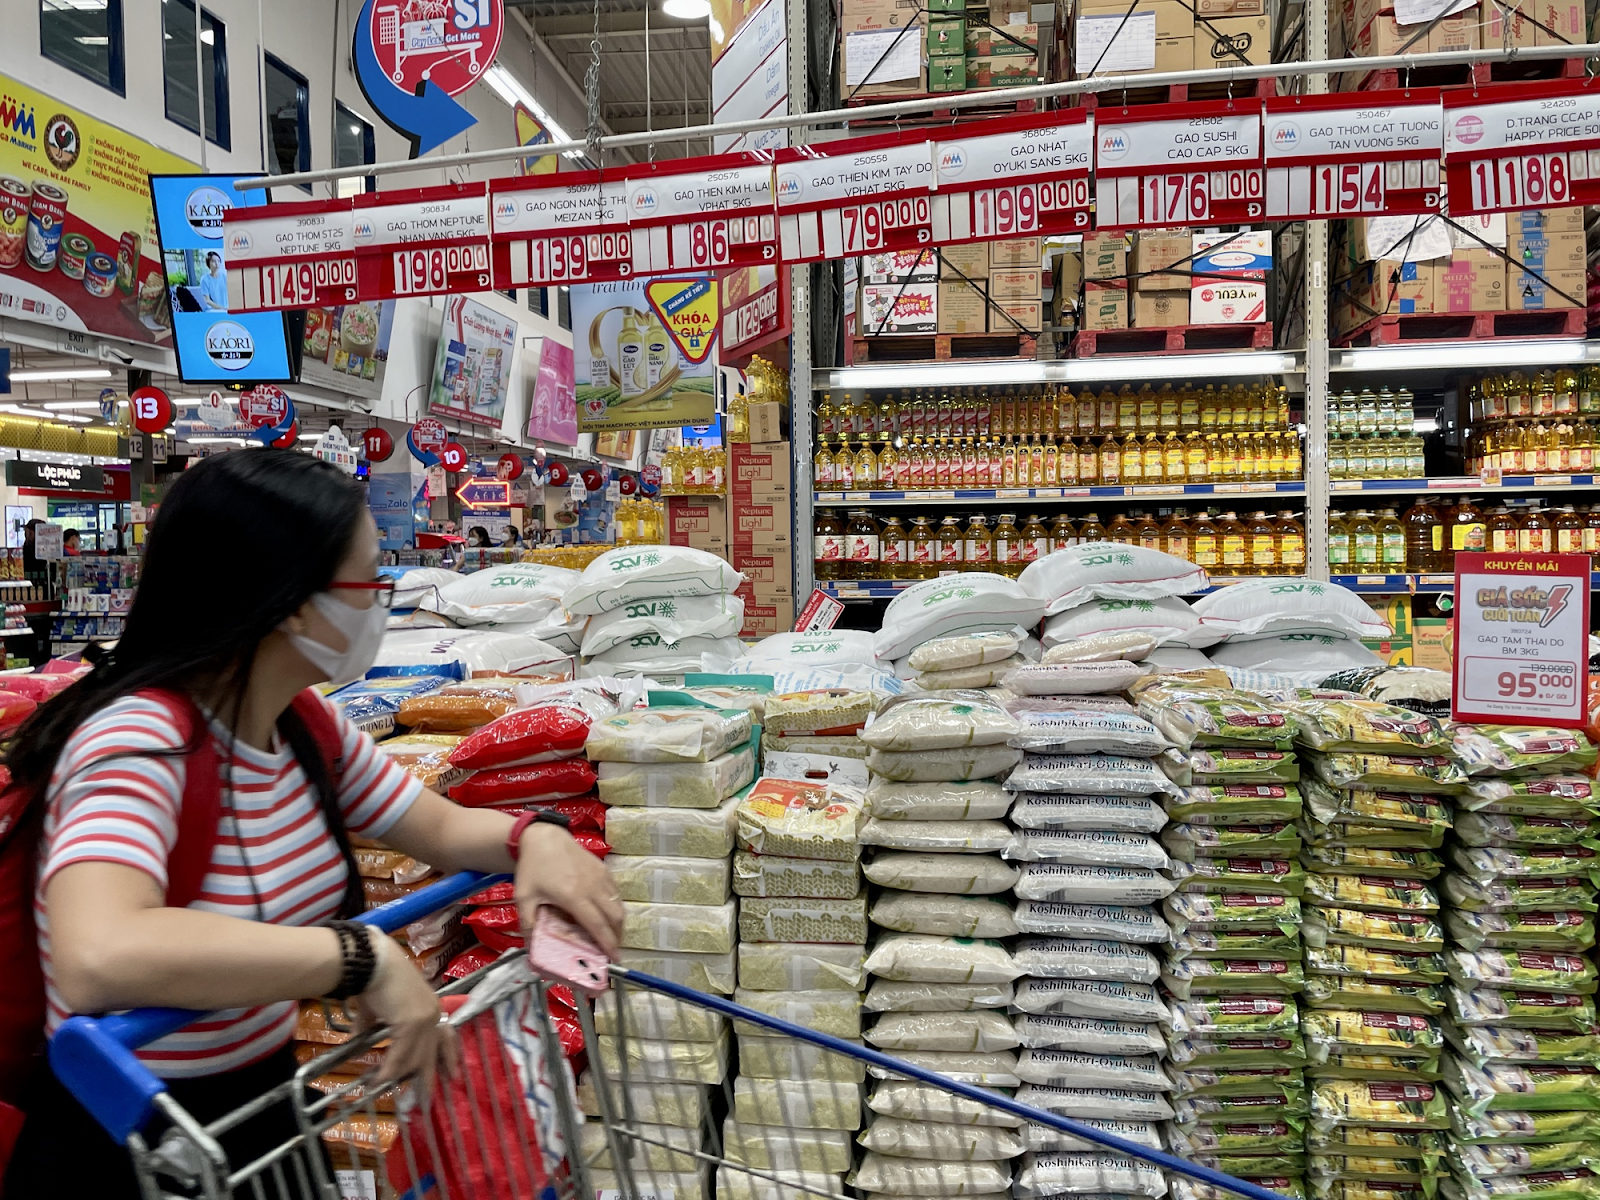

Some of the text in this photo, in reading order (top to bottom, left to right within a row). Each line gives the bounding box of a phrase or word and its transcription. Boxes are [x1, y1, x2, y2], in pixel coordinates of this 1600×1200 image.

[412, 38, 426, 48] Pay
[446, 34, 459, 43] Get
[460, 32, 480, 41] More
[1541, 99, 1577, 109] 324209
[1356, 110, 1391, 119] 350467
[1506, 112, 1593, 129] D.TRANG CCAP
[1189, 117, 1223, 127] 221502
[1021, 127, 1058, 139] 368052
[1309, 121, 1439, 138] GAO THOM CAT TUONG
[1505, 130, 1544, 143] HAPPY
[1548, 126, 1581, 138] PRICE
[1174, 131, 1237, 144] GAO SUSHI
[1329, 136, 1420, 150] TAN VUONG 5KG
[1010, 140, 1068, 157] GAO NHAT
[1167, 145, 1249, 159] CAO CAP 5KG
[854, 154, 888, 166] 250558
[993, 152, 1088, 174] OYUKI SANS 5KG
[22, 160, 32, 169] WE
[50, 171, 59, 180] WE
[60, 174, 71, 185] ARE
[72, 179, 91, 192] FAMILY
[707, 172, 740, 182] 250576
[812, 175, 835, 188] GAO
[837, 171, 869, 185] THIEN
[872, 168, 891, 180] KIM
[893, 164, 913, 178] TAY
[916, 162, 933, 173] DO
[566, 184, 597, 194] 350977
[674, 190, 694, 201] GAO
[697, 187, 724, 200] THIEN
[725, 185, 743, 196] KIM
[844, 180, 905, 198] VPHAT 5KG
[526, 196, 607, 212] GAO NGON NANG
[699, 197, 752, 212] VPHAT 5KG
[1424, 193, 1440, 207] Đ
[420, 204, 451, 215] 390834
[554, 210, 615, 223] MEIZAN 5KG
[1247, 202, 1263, 217] Đ
[296, 216, 326, 227] 390833
[387, 222, 407, 232] GAO
[410, 218, 438, 230] THOM
[440, 214, 485, 227] NEPTUNE
[1074, 211, 1089, 226] Đ
[275, 234, 294, 243] GAO
[296, 231, 321, 241] THOM
[399, 229, 476, 243] NHAN VANG 5KG
[917, 228, 931, 243] Đ
[280, 241, 341, 255] NEPTUNE 5KG
[1444, 274, 1476, 282] MEIZAN
[1215, 290, 1247, 299] YEUL
[672, 311, 711, 325] KHÓA
[68, 332, 84, 343] EXIT
[680, 324, 706, 338] GIÁ
[208, 337, 251, 349] KAORI
[136, 398, 158, 419] 13
[130, 441, 143, 453] 12
[153, 443, 166, 455] 11
[368, 436, 381, 452] 11
[444, 450, 460, 465] 10
[738, 455, 770, 466] Neptune
[38, 464, 81, 480] LỘC PHÚC
[551, 468, 560, 479] 8
[740, 467, 761, 479] Light
[588, 475, 596, 484] 7
[622, 480, 630, 491] 6
[388, 499, 409, 508] Zalo
[677, 507, 708, 519] Neptune
[677, 519, 698, 531] Light
[1484, 558, 1559, 572] KHUYẾN MÃI
[1477, 586, 1549, 609] GIÁ SỐC
[625, 602, 657, 619] ADC
[1477, 635, 1565, 647] GAO TAM THAI DO
[1502, 647, 1539, 656] BM 3KG
[1136, 723, 1154, 733] san
[1028, 758, 1153, 772] Koshihikari-Oyuki san
[1027, 797, 1151, 809] Koshihikari-Oyuki san
[1024, 829, 1148, 846] Koshihikari-Oyuki san
[1028, 865, 1154, 879] Koshihikari-Oyuki san
